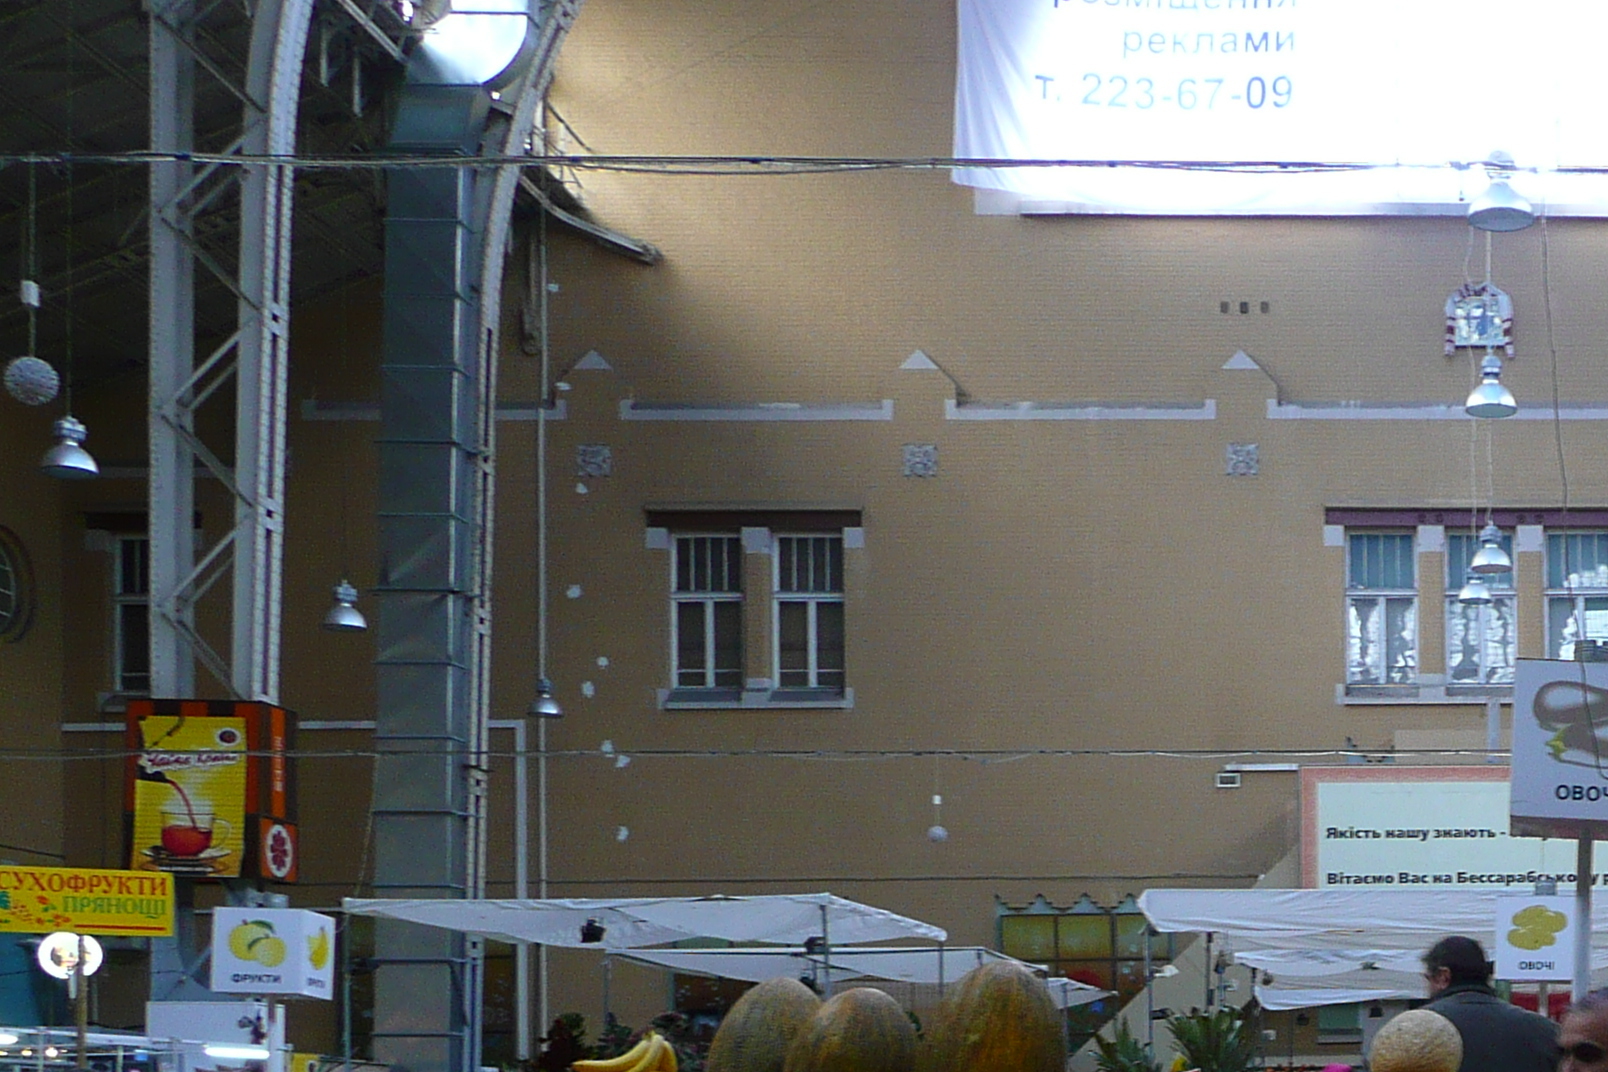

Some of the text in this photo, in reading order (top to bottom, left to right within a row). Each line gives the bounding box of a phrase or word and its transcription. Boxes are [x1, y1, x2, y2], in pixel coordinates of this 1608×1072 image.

[1123, 31, 1295, 58] реклами
[1081, 73, 1293, 110] 223-67-09
[1326, 827, 1382, 839] Якість
[1385, 829, 1430, 842] нашу
[1433, 829, 1497, 839] знають
[1327, 872, 1395, 884] Вітаємо
[1399, 873, 1428, 884] Вас
[1433, 874, 1453, 883] на
[1457, 871, 1598, 886] Бессарабськоу
[231, 973, 282, 983] ФРУКТИ
